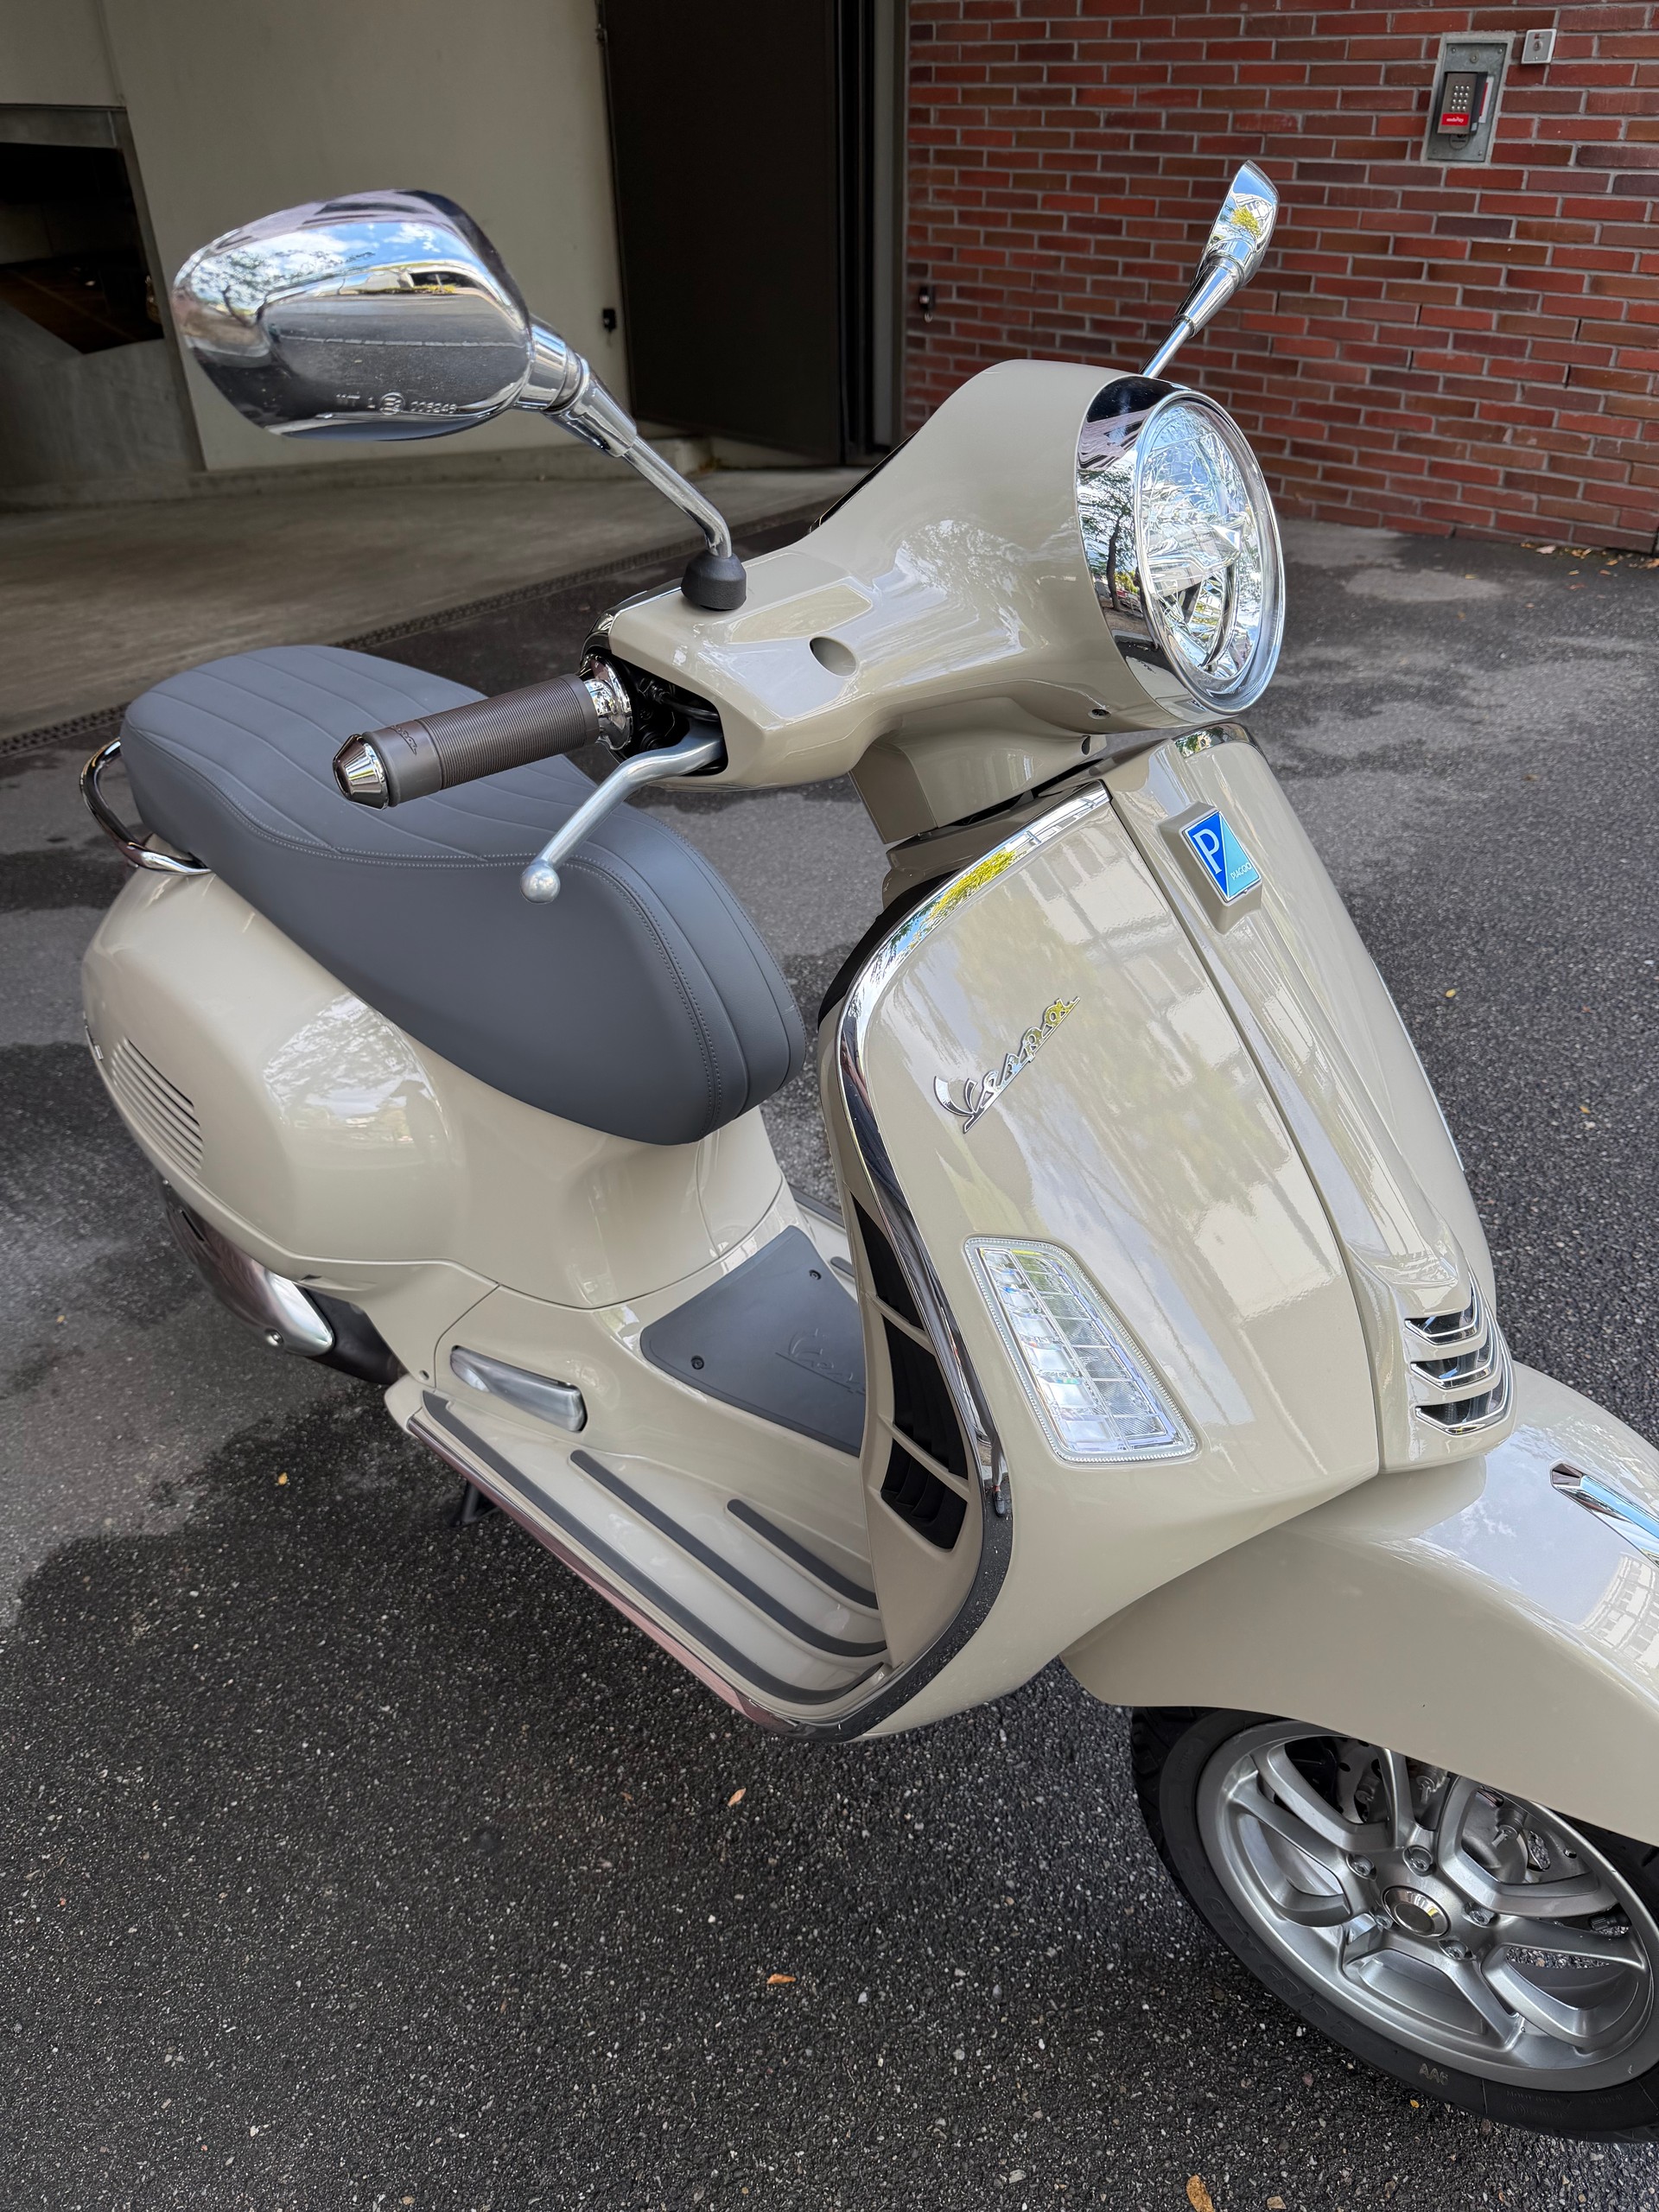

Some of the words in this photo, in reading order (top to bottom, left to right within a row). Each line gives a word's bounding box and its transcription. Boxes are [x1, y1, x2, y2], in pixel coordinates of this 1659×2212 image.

[1192, 829, 1222, 874] P
[1230, 862, 1252, 880] PIAGGIO
[933, 996, 1081, 1134] Vespa
